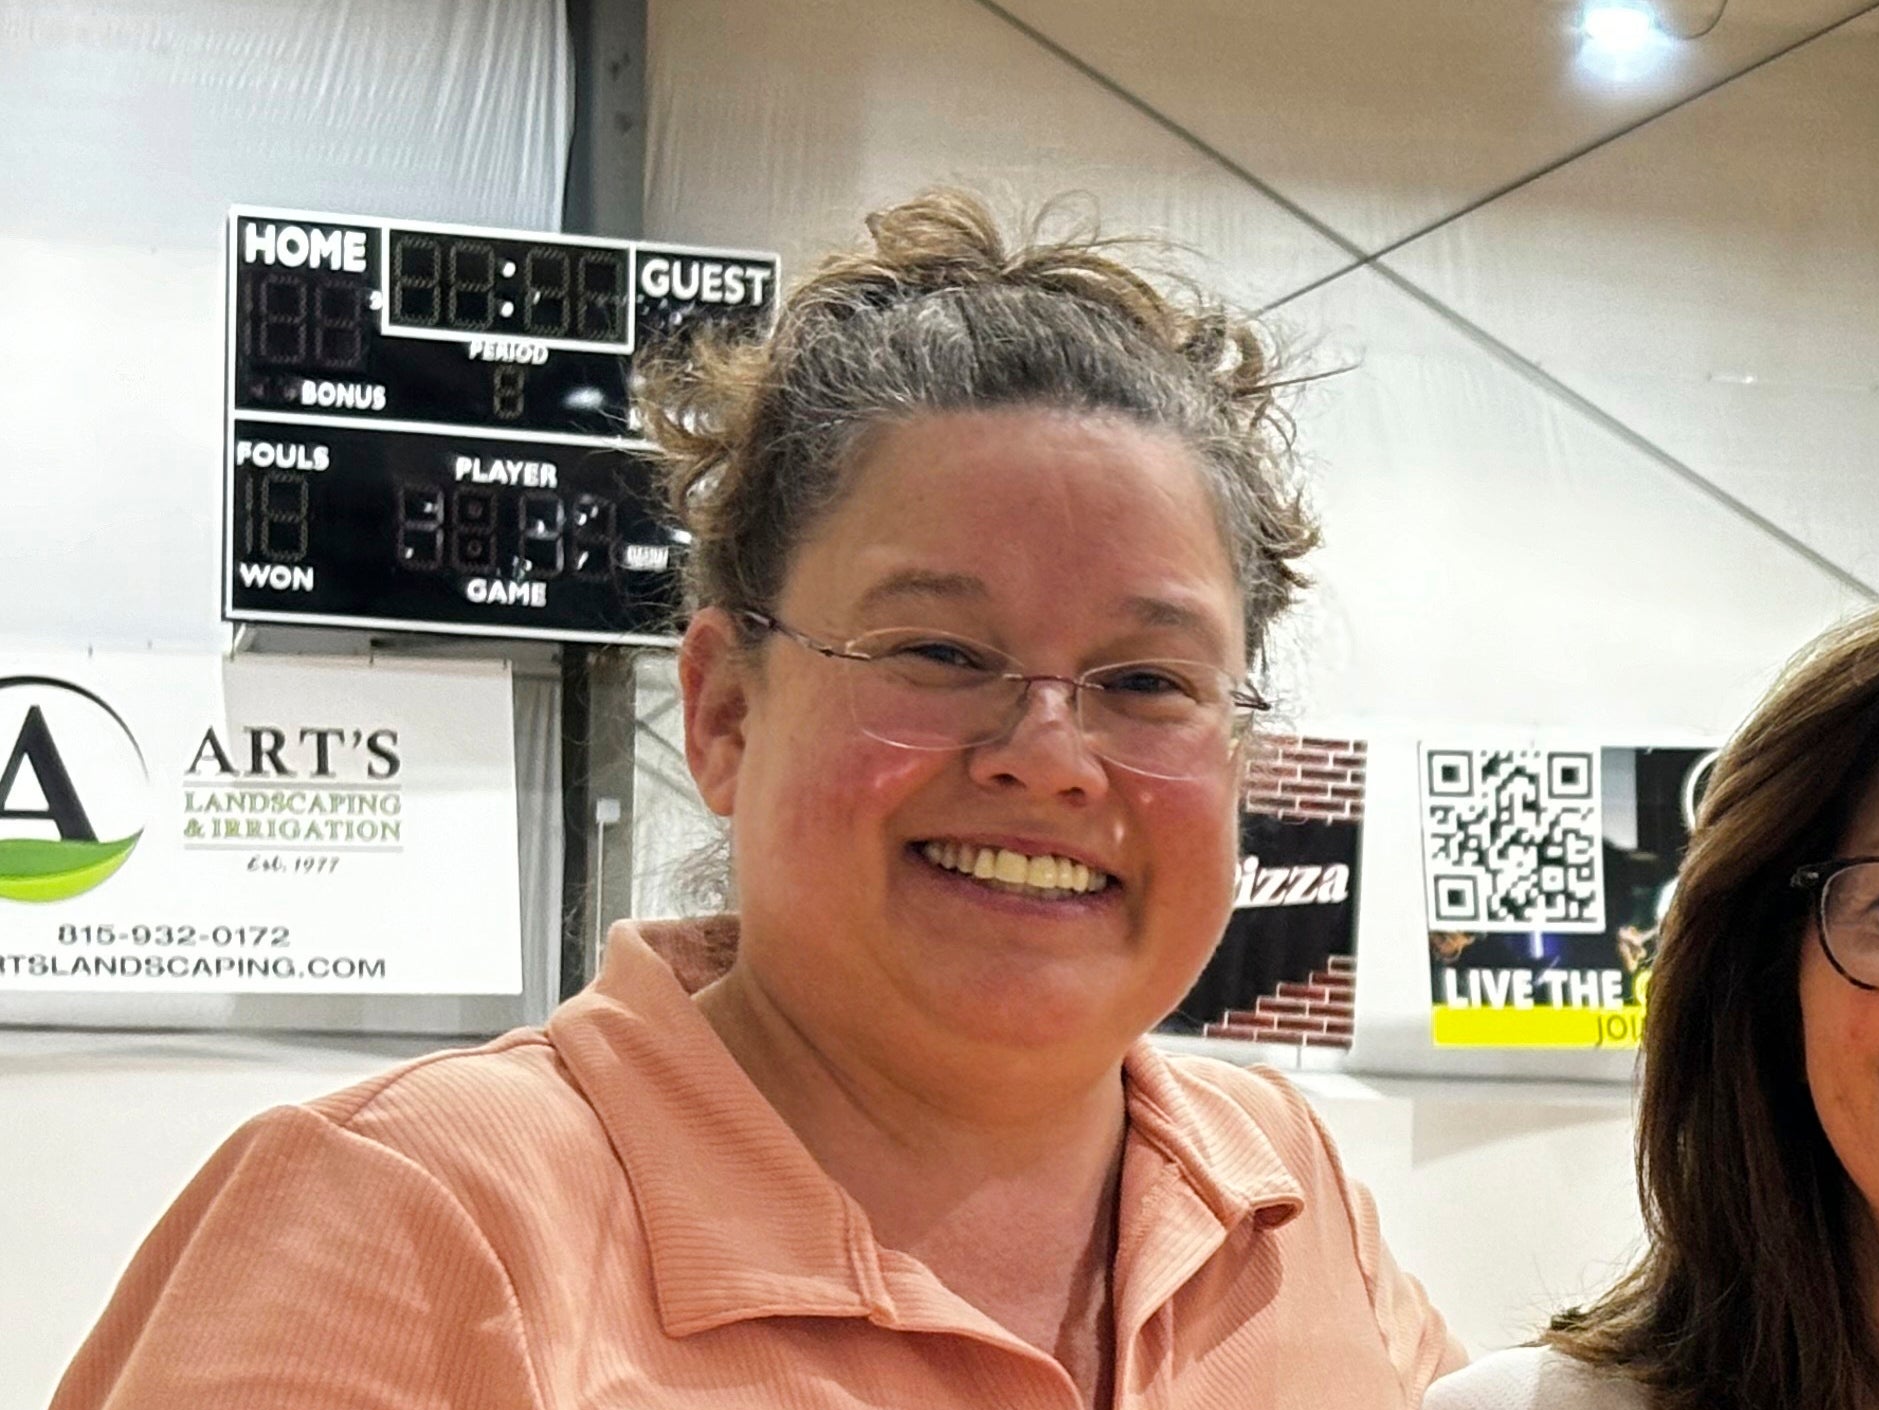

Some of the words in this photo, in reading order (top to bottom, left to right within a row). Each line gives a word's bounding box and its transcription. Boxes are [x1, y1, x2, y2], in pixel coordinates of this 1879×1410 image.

[244, 222, 367, 273] HOME
[641, 258, 771, 306] GUEST
[468, 341, 549, 366] PERIOD
[301, 379, 386, 411] BONUS
[236, 440, 330, 471] FOULS
[455, 456, 558, 488] PLAYER
[240, 562, 314, 592] WON
[466, 578, 548, 608] GAME
[184, 726, 401, 780] ART'S
[184, 790, 402, 816] LANDSCAPING
[183, 818, 205, 838] &
[211, 819, 402, 842] IRRIGATION
[1233, 855, 1350, 907] izza
[58, 924, 291, 947] 815-932-0172
[1445, 968, 1534, 1011] LIVE
[1543, 969, 1625, 1012] THE
